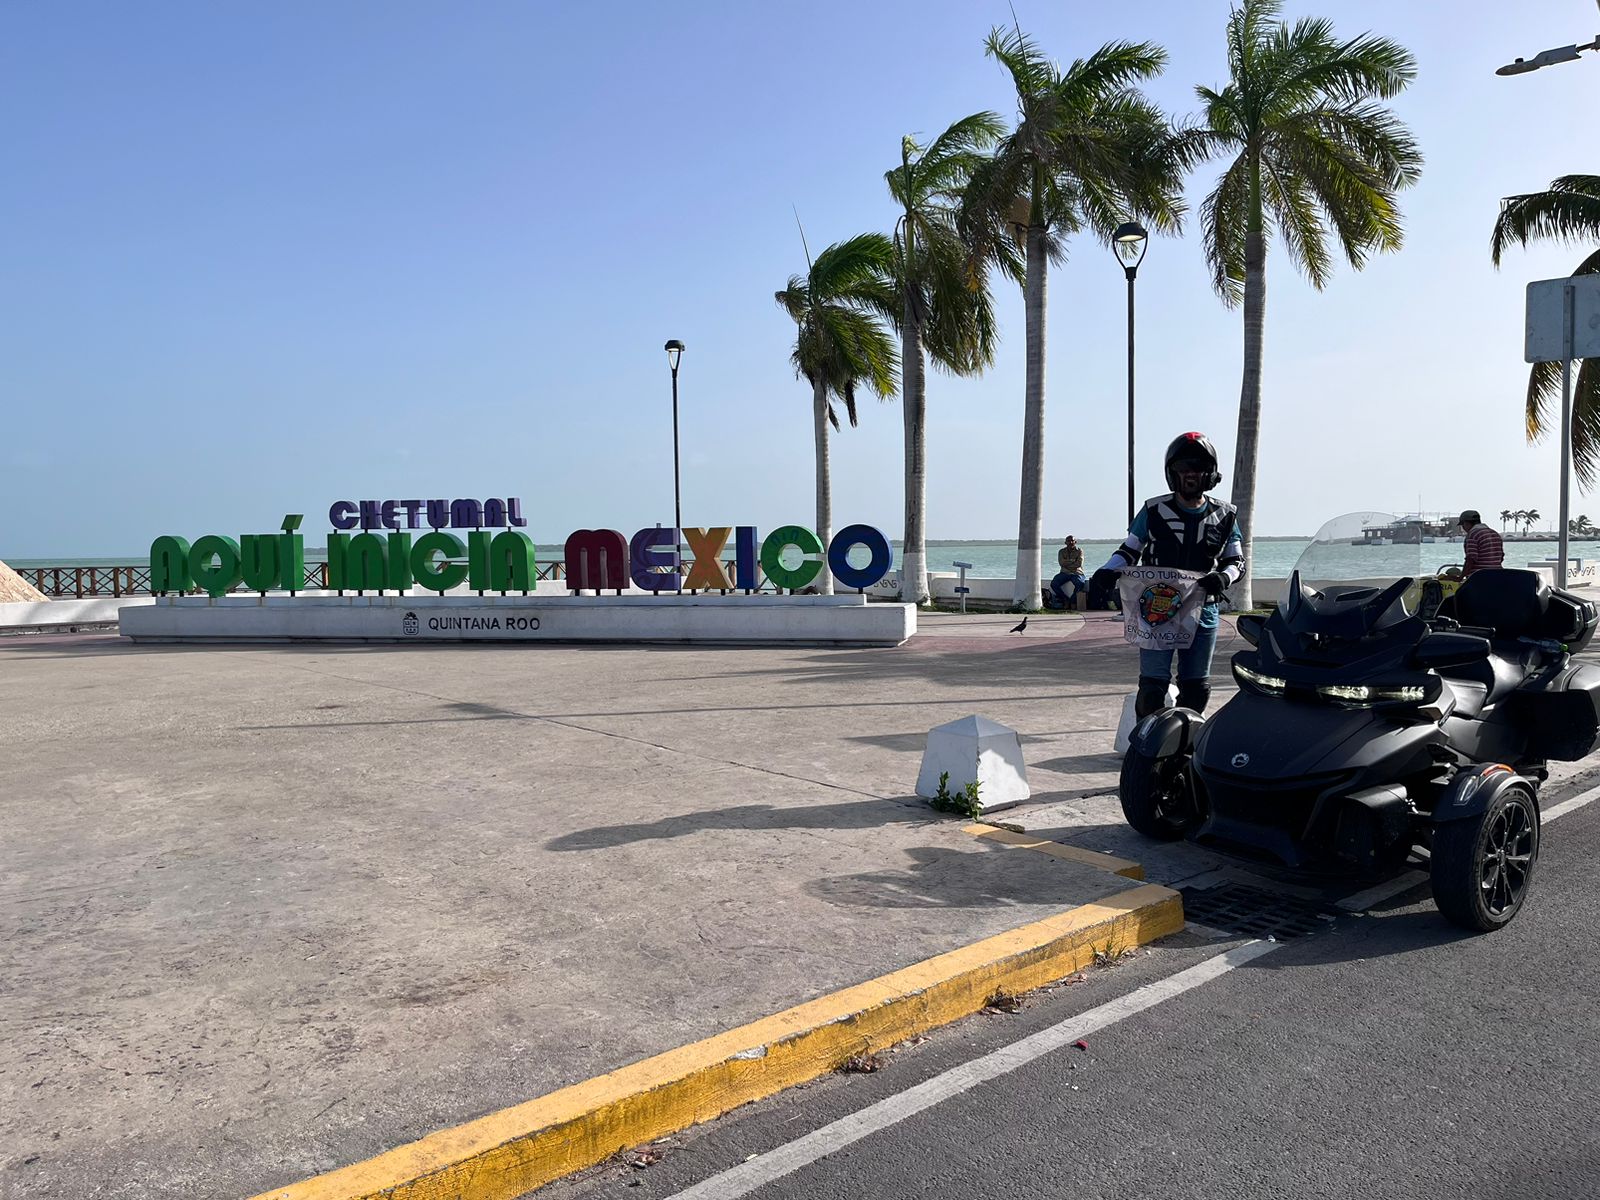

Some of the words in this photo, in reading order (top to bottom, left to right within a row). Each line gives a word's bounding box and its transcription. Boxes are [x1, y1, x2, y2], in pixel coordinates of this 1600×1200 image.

[329, 498, 527, 529] CHETUMAL
[150, 514, 304, 598] AQUÍ
[327, 531, 536, 591] INICIA
[1123, 570, 1155, 579] MOTO
[428, 617, 501, 631] QUINTANA
[506, 617, 540, 630] ROO
